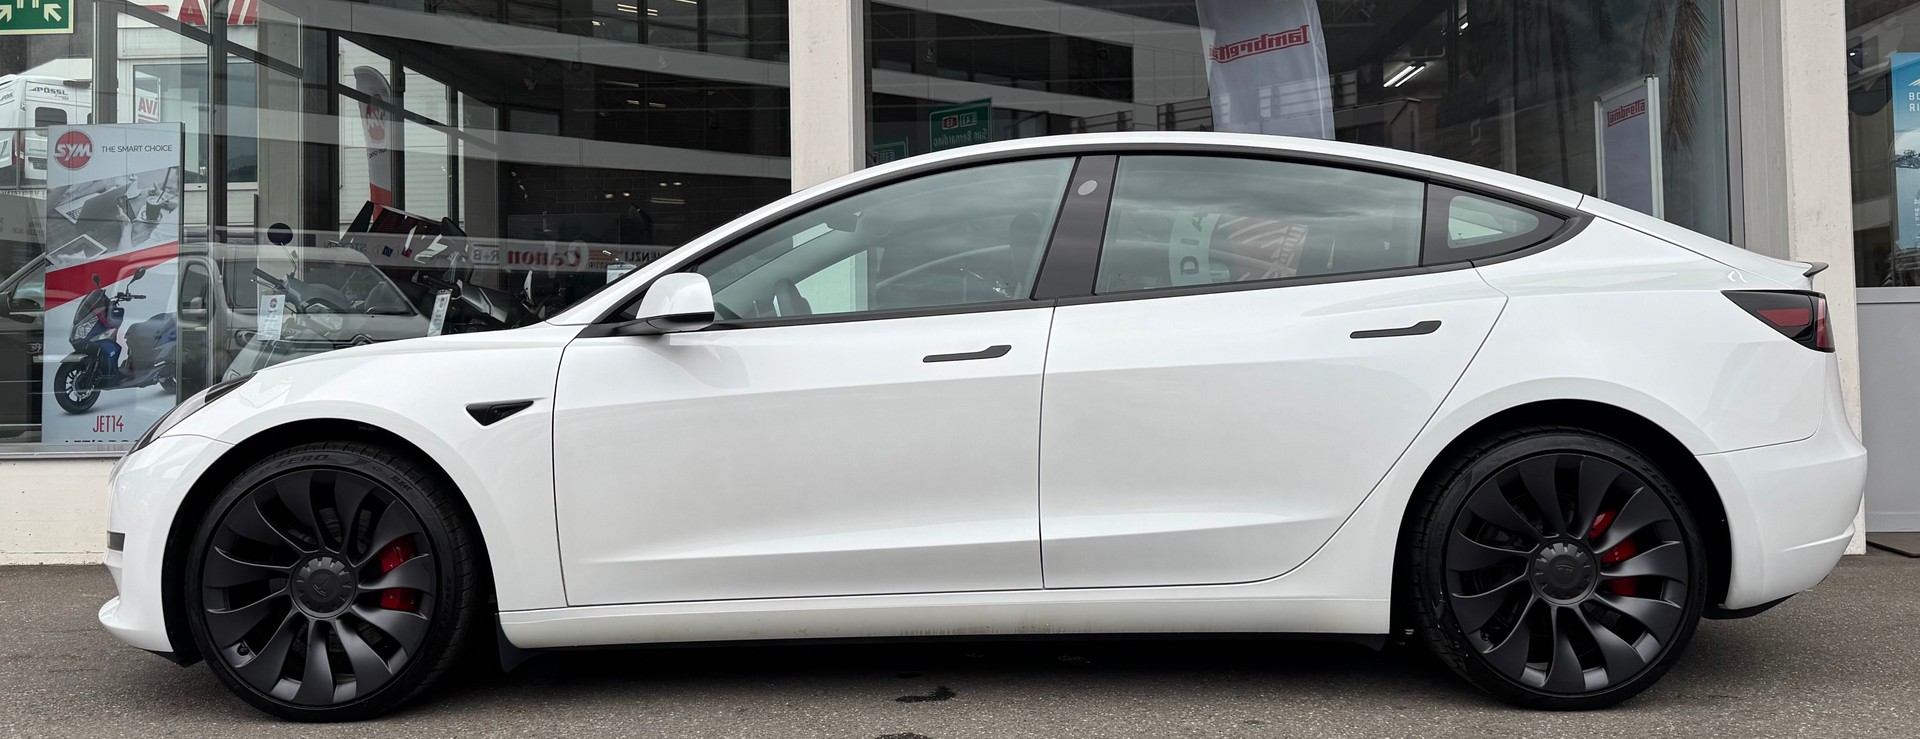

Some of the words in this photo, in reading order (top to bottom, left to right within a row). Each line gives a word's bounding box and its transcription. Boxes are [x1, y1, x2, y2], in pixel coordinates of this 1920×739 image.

[53, 142, 93, 162] SYM
[101, 145, 116, 153] THE
[117, 144, 143, 153] SMART
[144, 144, 173, 153] CHOICE
[92, 415, 124, 433] JET14
